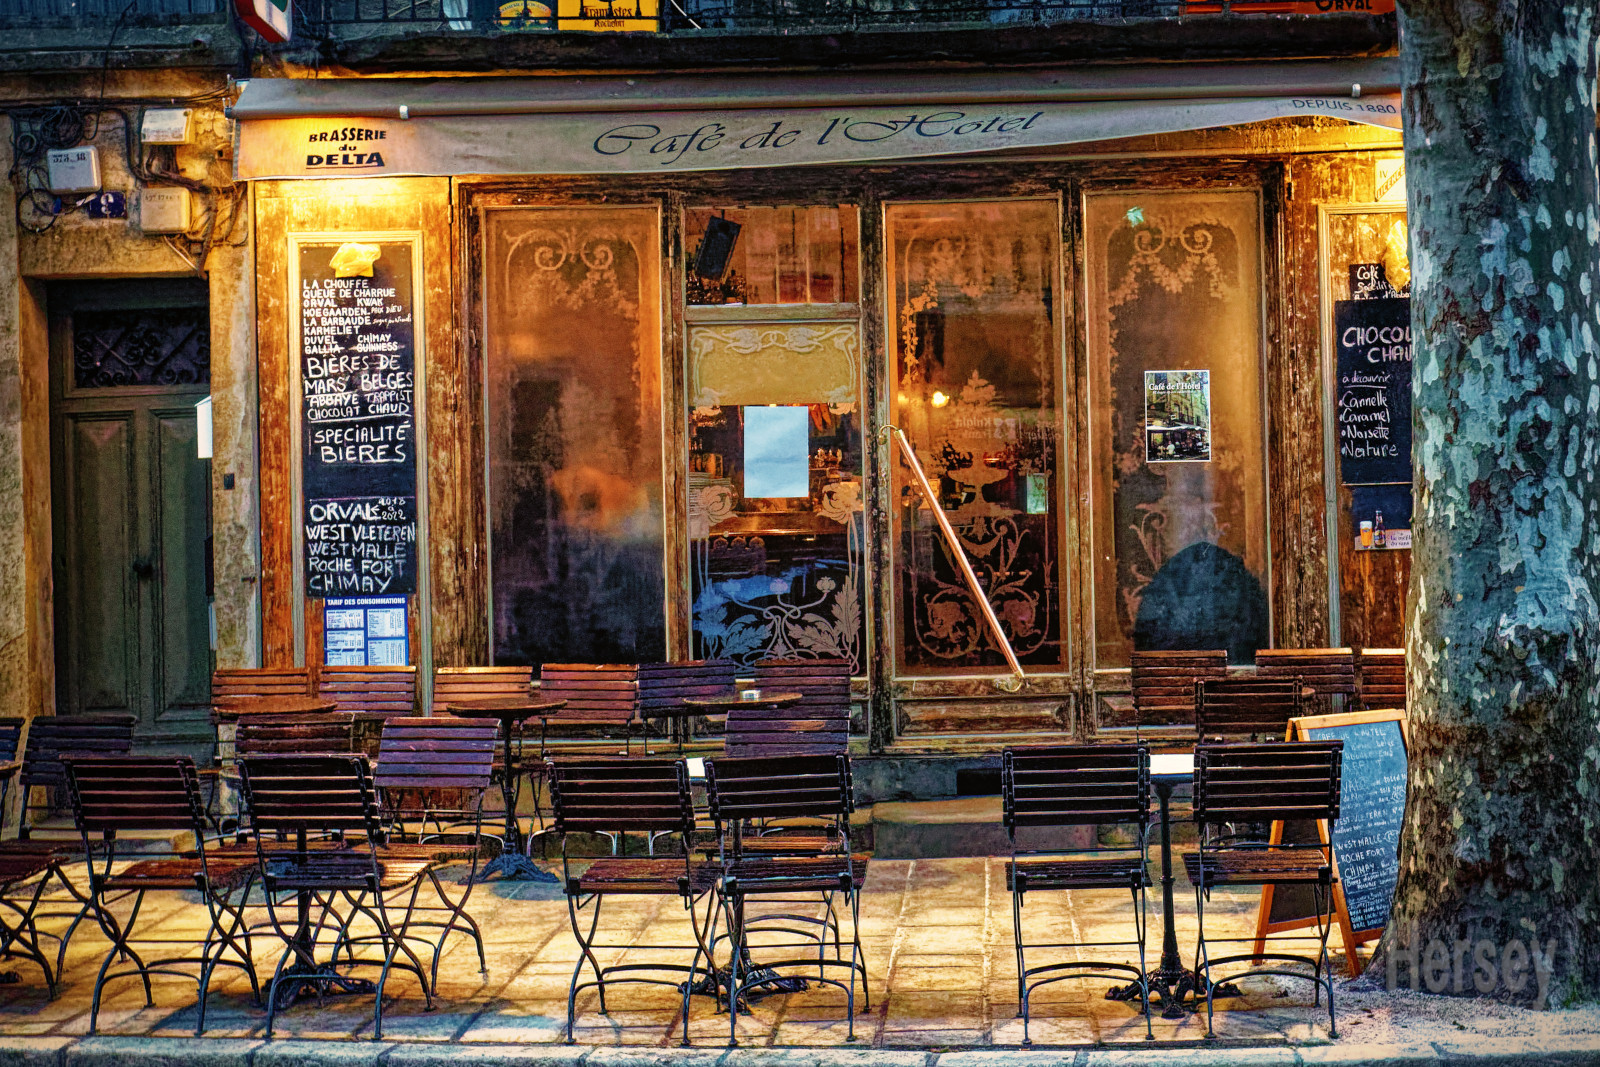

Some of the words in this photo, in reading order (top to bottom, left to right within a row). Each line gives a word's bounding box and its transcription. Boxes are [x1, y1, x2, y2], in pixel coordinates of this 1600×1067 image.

[1293, 99, 1351, 111] DEPUIS
[1357, 104, 1397, 115] 1880
[308, 127, 387, 142] BRASSERIE
[593, 123, 727, 164] Café
[740, 121, 802, 151] de
[306, 152, 385, 167] DELTA
[303, 279, 319, 289] LA
[324, 279, 369, 289] CHOUFFE
[303, 289, 336, 299] QUEUE
[339, 289, 352, 298] DE
[353, 288, 396, 298] CHARRUE
[303, 298, 338, 308] ORVAL
[356, 298, 384, 307] KWAK
[303, 317, 317, 326] LA
[321, 316, 372, 326] BARBAUDE
[304, 326, 361, 336] KARMELIET
[304, 335, 338, 345] DUVEL
[374, 354, 401, 370] DE
[361, 372, 413, 391] BELGES
[1148, 383, 1166, 391] Café
[1166, 382, 1176, 390] de
[309, 393, 360, 408] ABBAYE
[307, 406, 360, 420] CHOCOLAT
[368, 402, 410, 415] CHAUD
[1341, 407, 1390, 423] Caramel
[1346, 423, 1390, 440] Noisette
[1345, 440, 1399, 458] Nature
[310, 502, 382, 522] ORVAL
[309, 573, 392, 594] CHIMAY
[356, 597, 406, 605] CONSOMMATIONS
